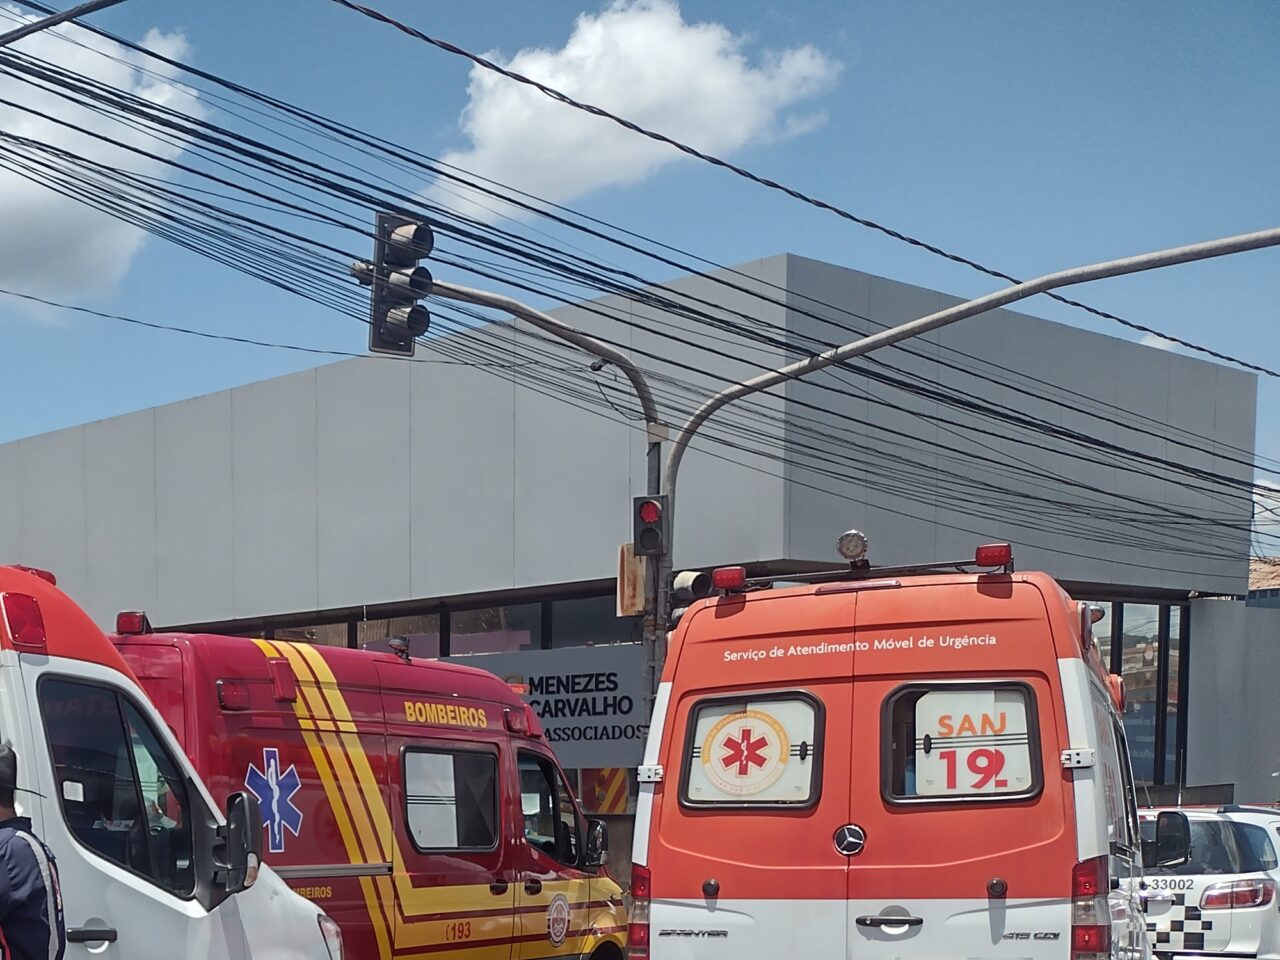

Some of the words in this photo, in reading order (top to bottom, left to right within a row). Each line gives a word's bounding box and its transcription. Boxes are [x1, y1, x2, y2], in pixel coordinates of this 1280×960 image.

[723, 649, 766, 662] Serviço
[769, 645, 785, 658] de
[787, 640, 869, 657] Atendimento
[873, 636, 913, 650] Móvel
[918, 635, 935, 647] de
[939, 633, 997, 649] Urgência
[528, 672, 619, 695] MENEZES
[403, 701, 488, 728] BOMBEIROS
[530, 695, 634, 718] CARVALHO
[293, 886, 332, 899] BEIROS
[451, 921, 471, 940] 193
